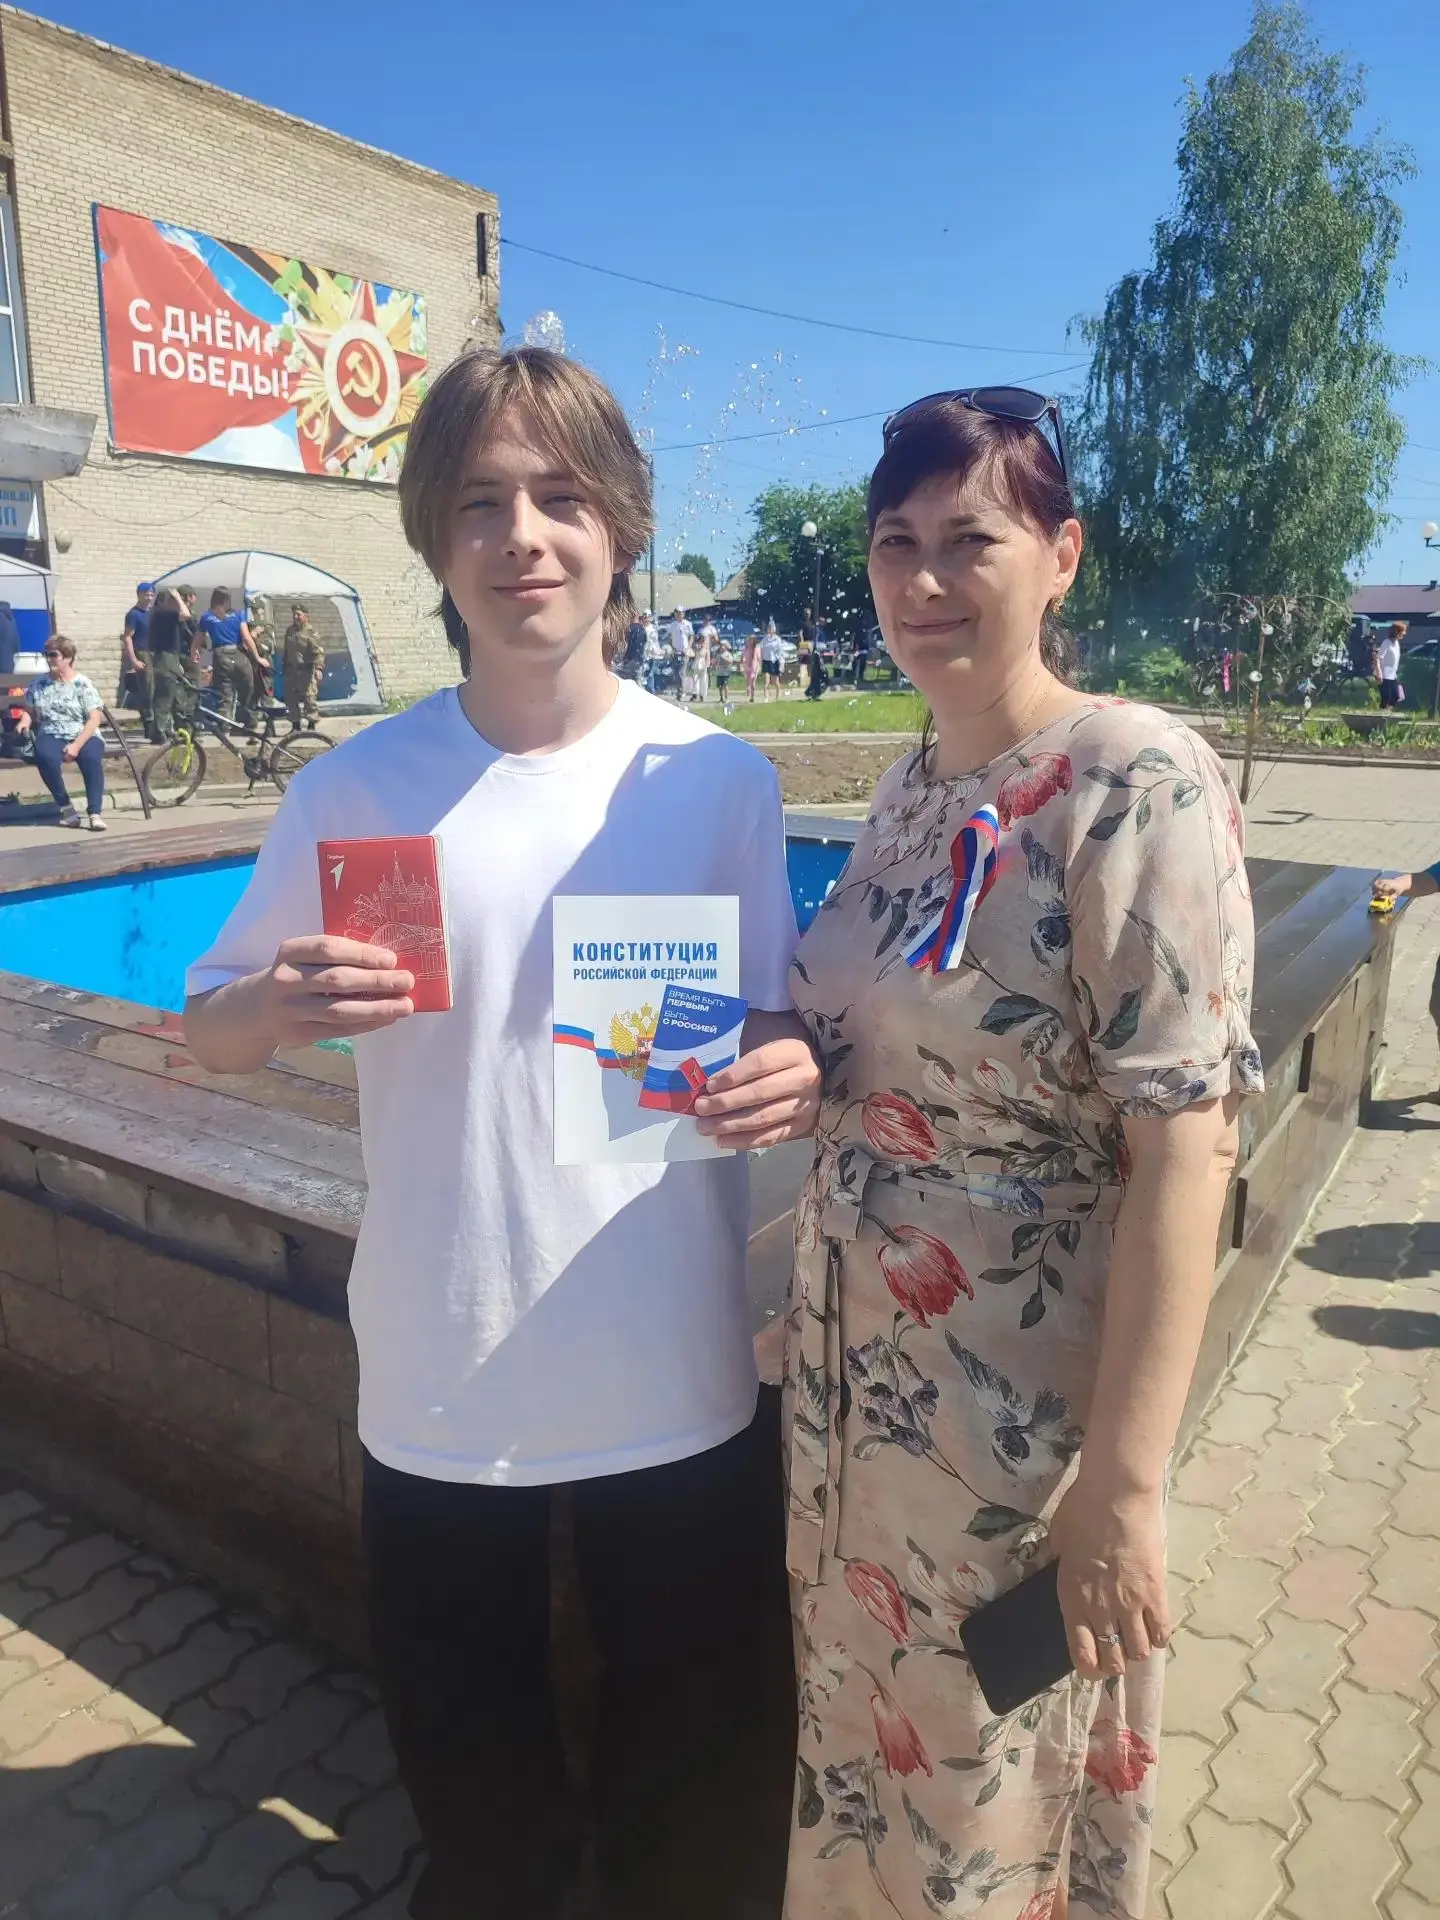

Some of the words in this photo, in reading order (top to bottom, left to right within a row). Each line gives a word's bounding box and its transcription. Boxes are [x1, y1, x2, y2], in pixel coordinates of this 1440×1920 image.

[128, 298, 153, 333] С
[161, 304, 262, 356] ДНЁМ
[132, 339, 290, 400] ПОБЕДЫ!
[572, 942, 718, 964] КОНСТИТУЦИЯ
[573, 966, 647, 980] РОССИЙСКОЙ
[650, 967, 717, 981] ФЕДЕРАЦИИ
[666, 997, 710, 1012] ПЕРВЫМ
[668, 990, 701, 1002] ВРЕМЯ
[702, 996, 726, 1008] БЫТЬ
[663, 1009, 689, 1021] БЫТЬ
[670, 1019, 718, 1034] РОССИЕЙ
